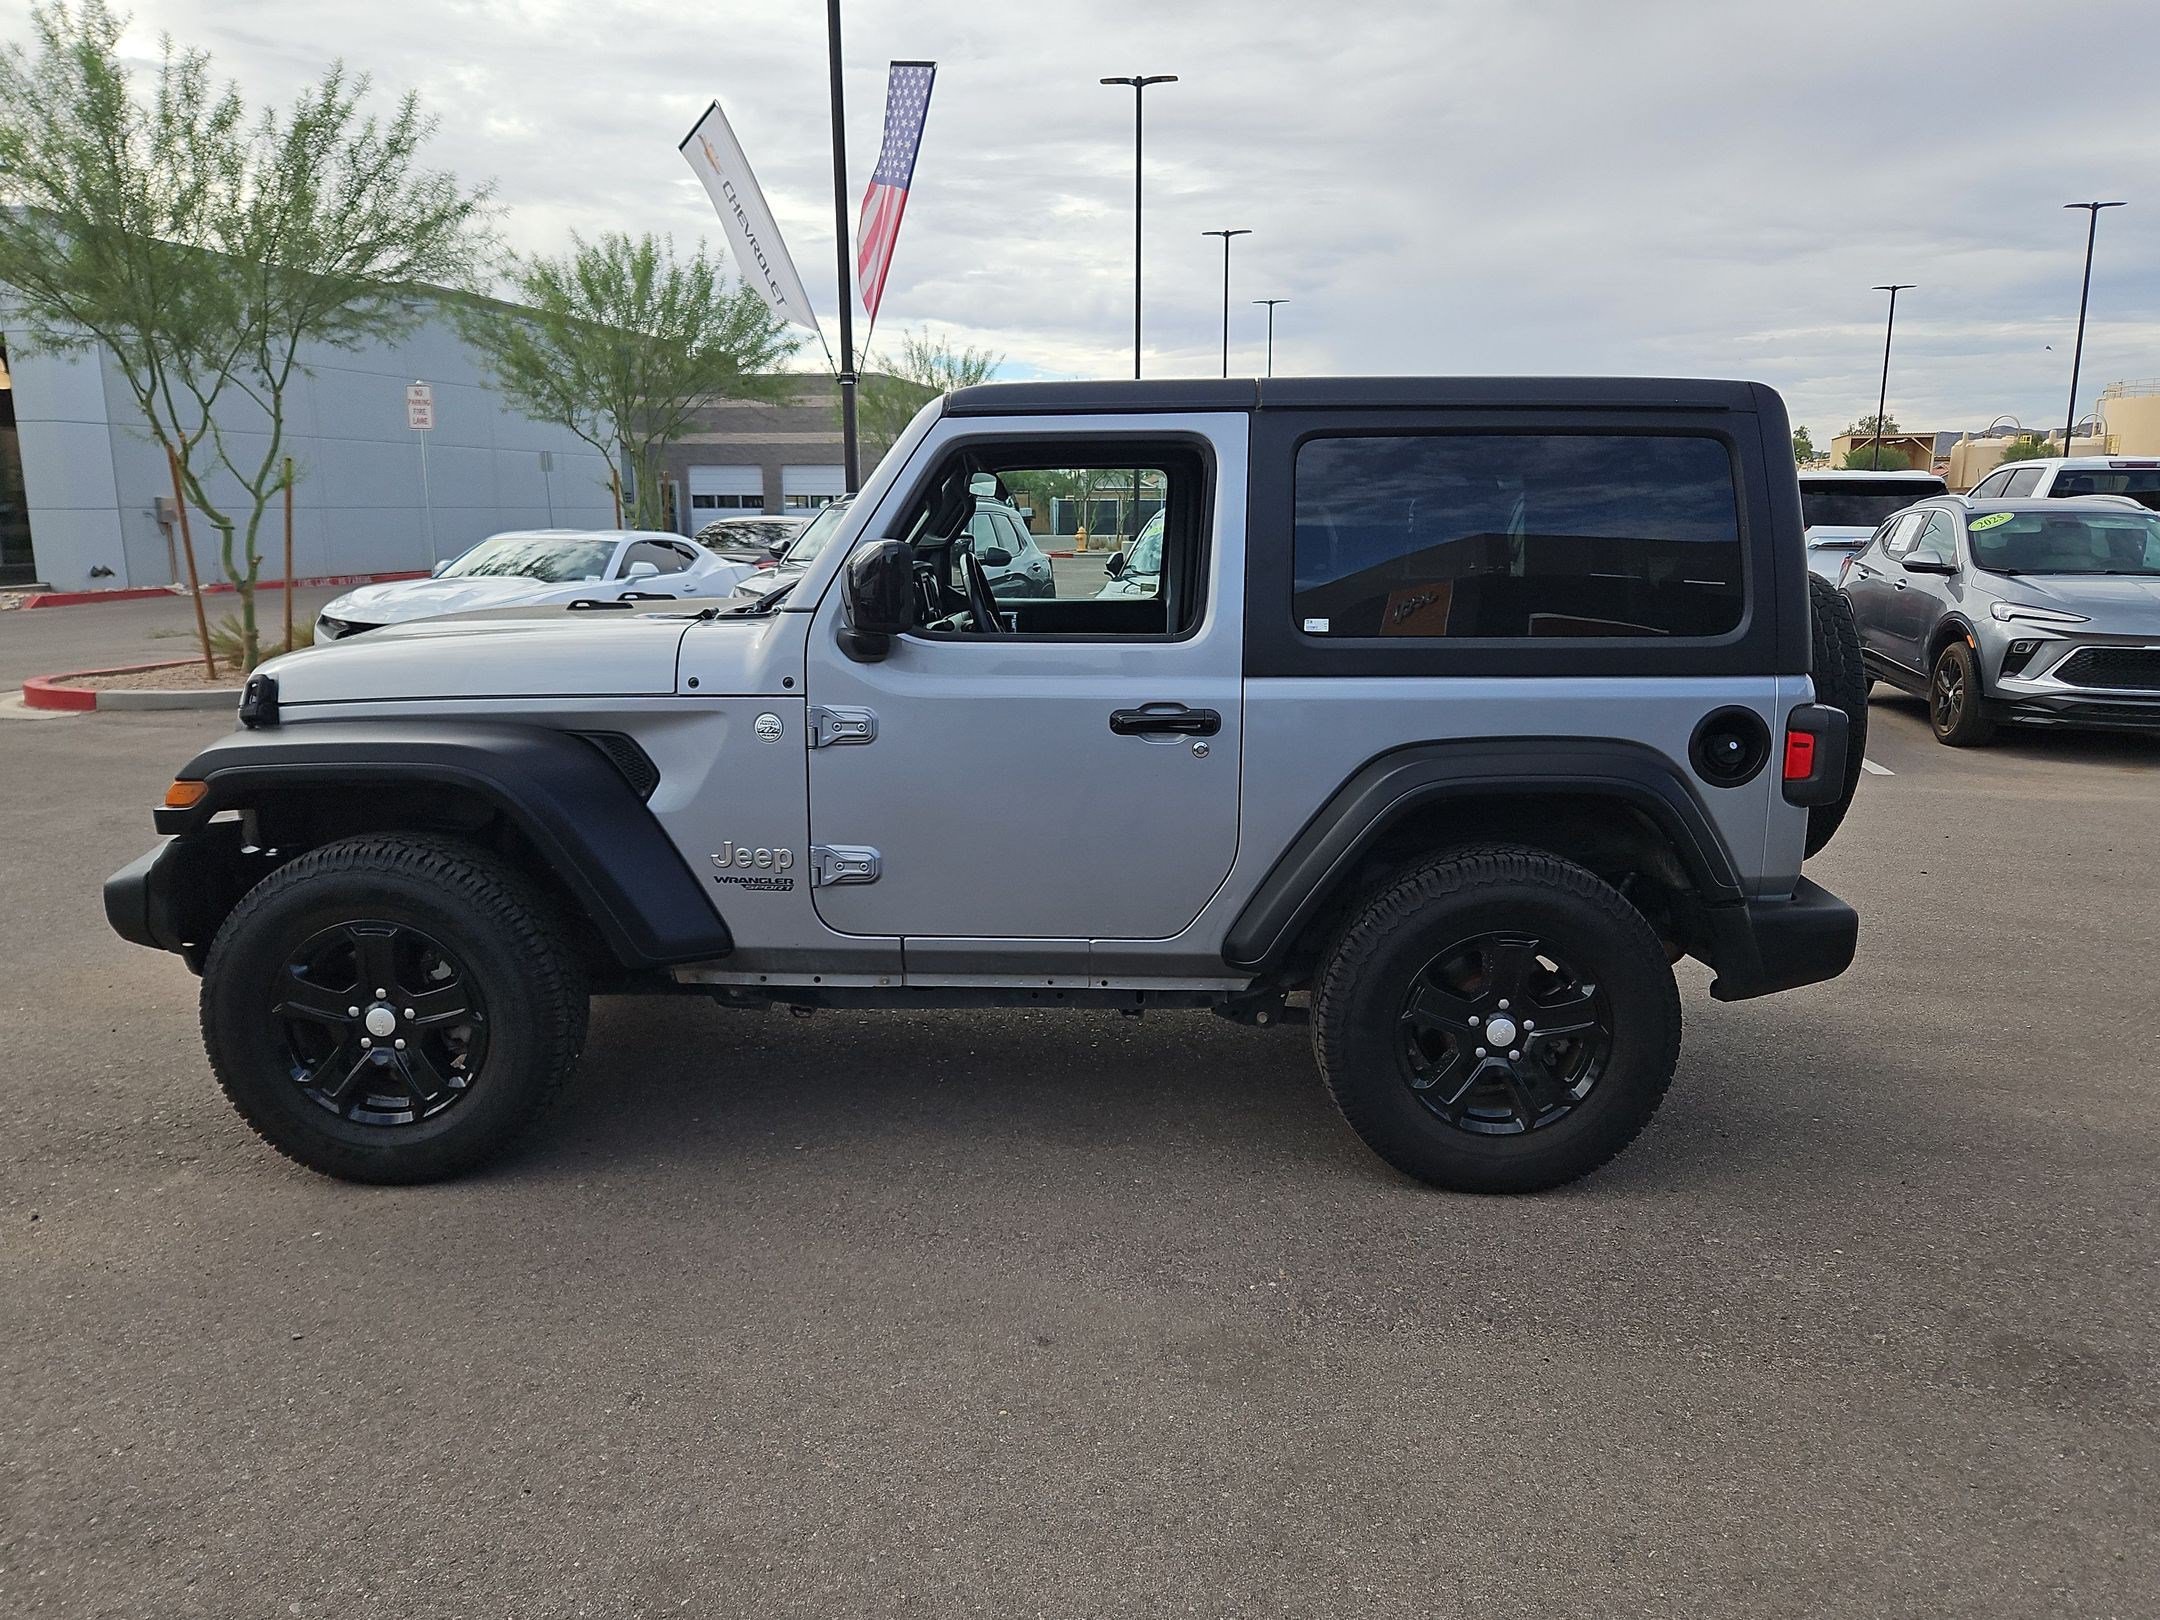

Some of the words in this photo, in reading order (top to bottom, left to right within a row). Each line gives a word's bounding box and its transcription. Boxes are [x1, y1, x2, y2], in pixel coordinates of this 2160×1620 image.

[722, 180, 788, 306] CHEVROLET
[414, 389, 423, 397] NO
[1977, 514, 2005, 528] 2025
[710, 840, 794, 873] Jeep
[713, 875, 794, 885] WRANGLER
